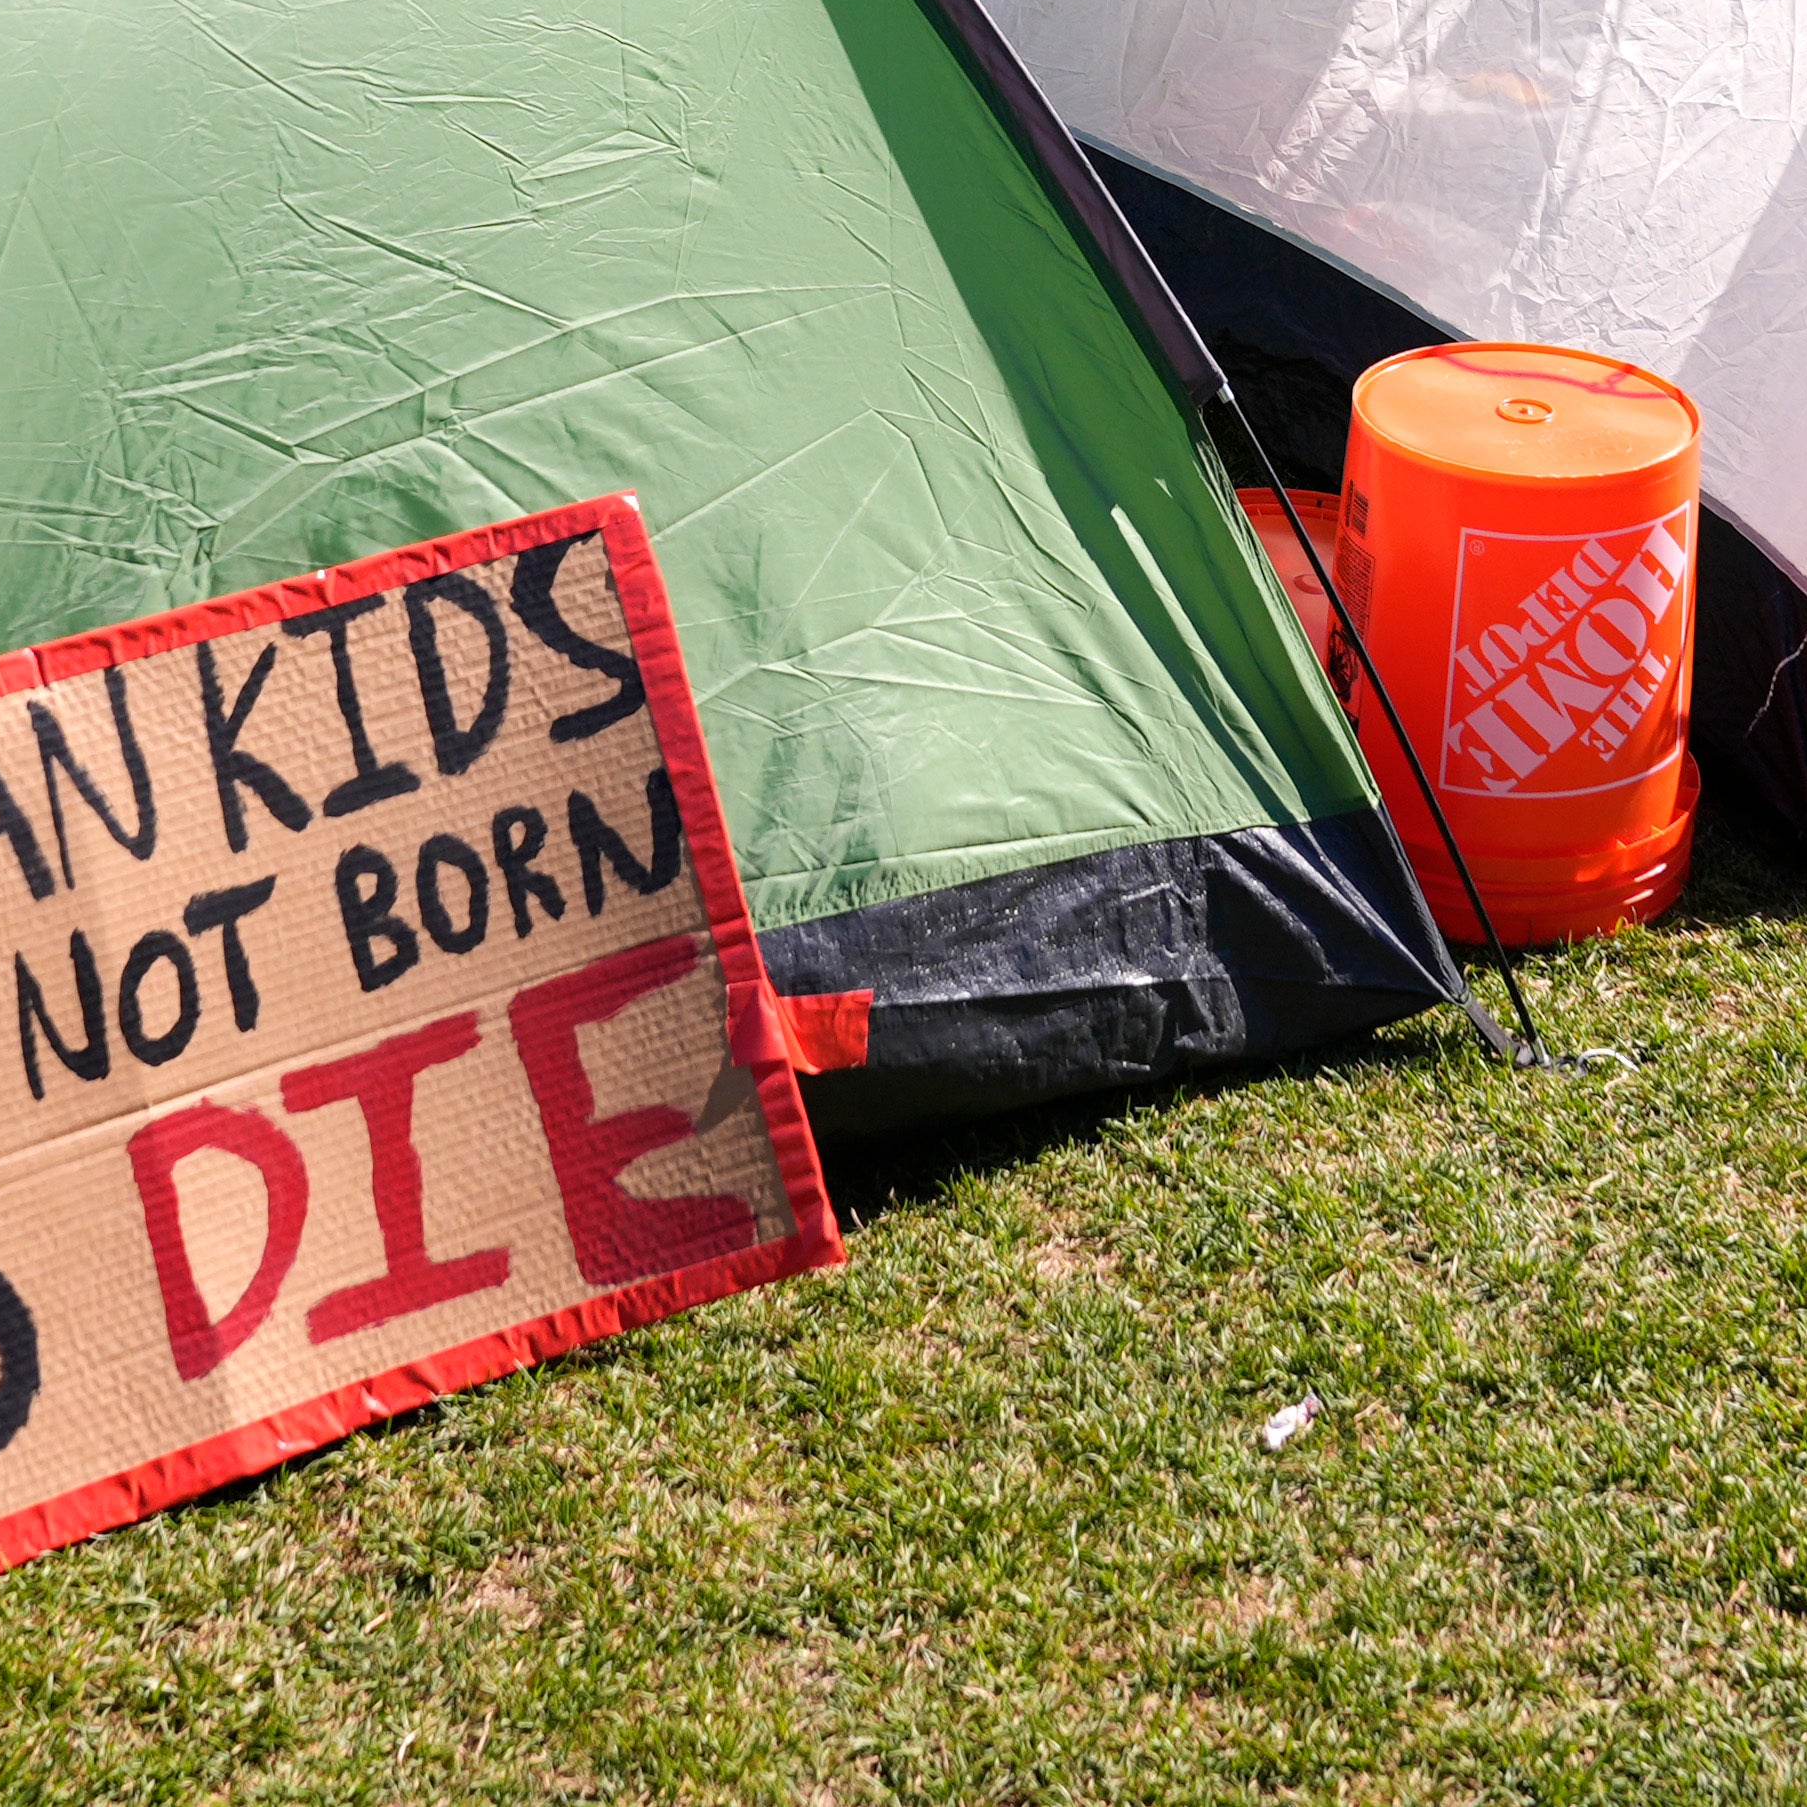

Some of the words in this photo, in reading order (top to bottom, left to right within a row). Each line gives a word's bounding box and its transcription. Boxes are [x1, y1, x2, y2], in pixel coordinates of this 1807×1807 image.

[192, 529, 646, 854] KIDS
[1447, 521, 1687, 793] HOME
[1454, 538, 1621, 698] DEPOT
[1579, 648, 1672, 764] THE
[15, 875, 277, 1100] NOT
[335, 768, 685, 993] BORN
[126, 934, 763, 1384] DIE
